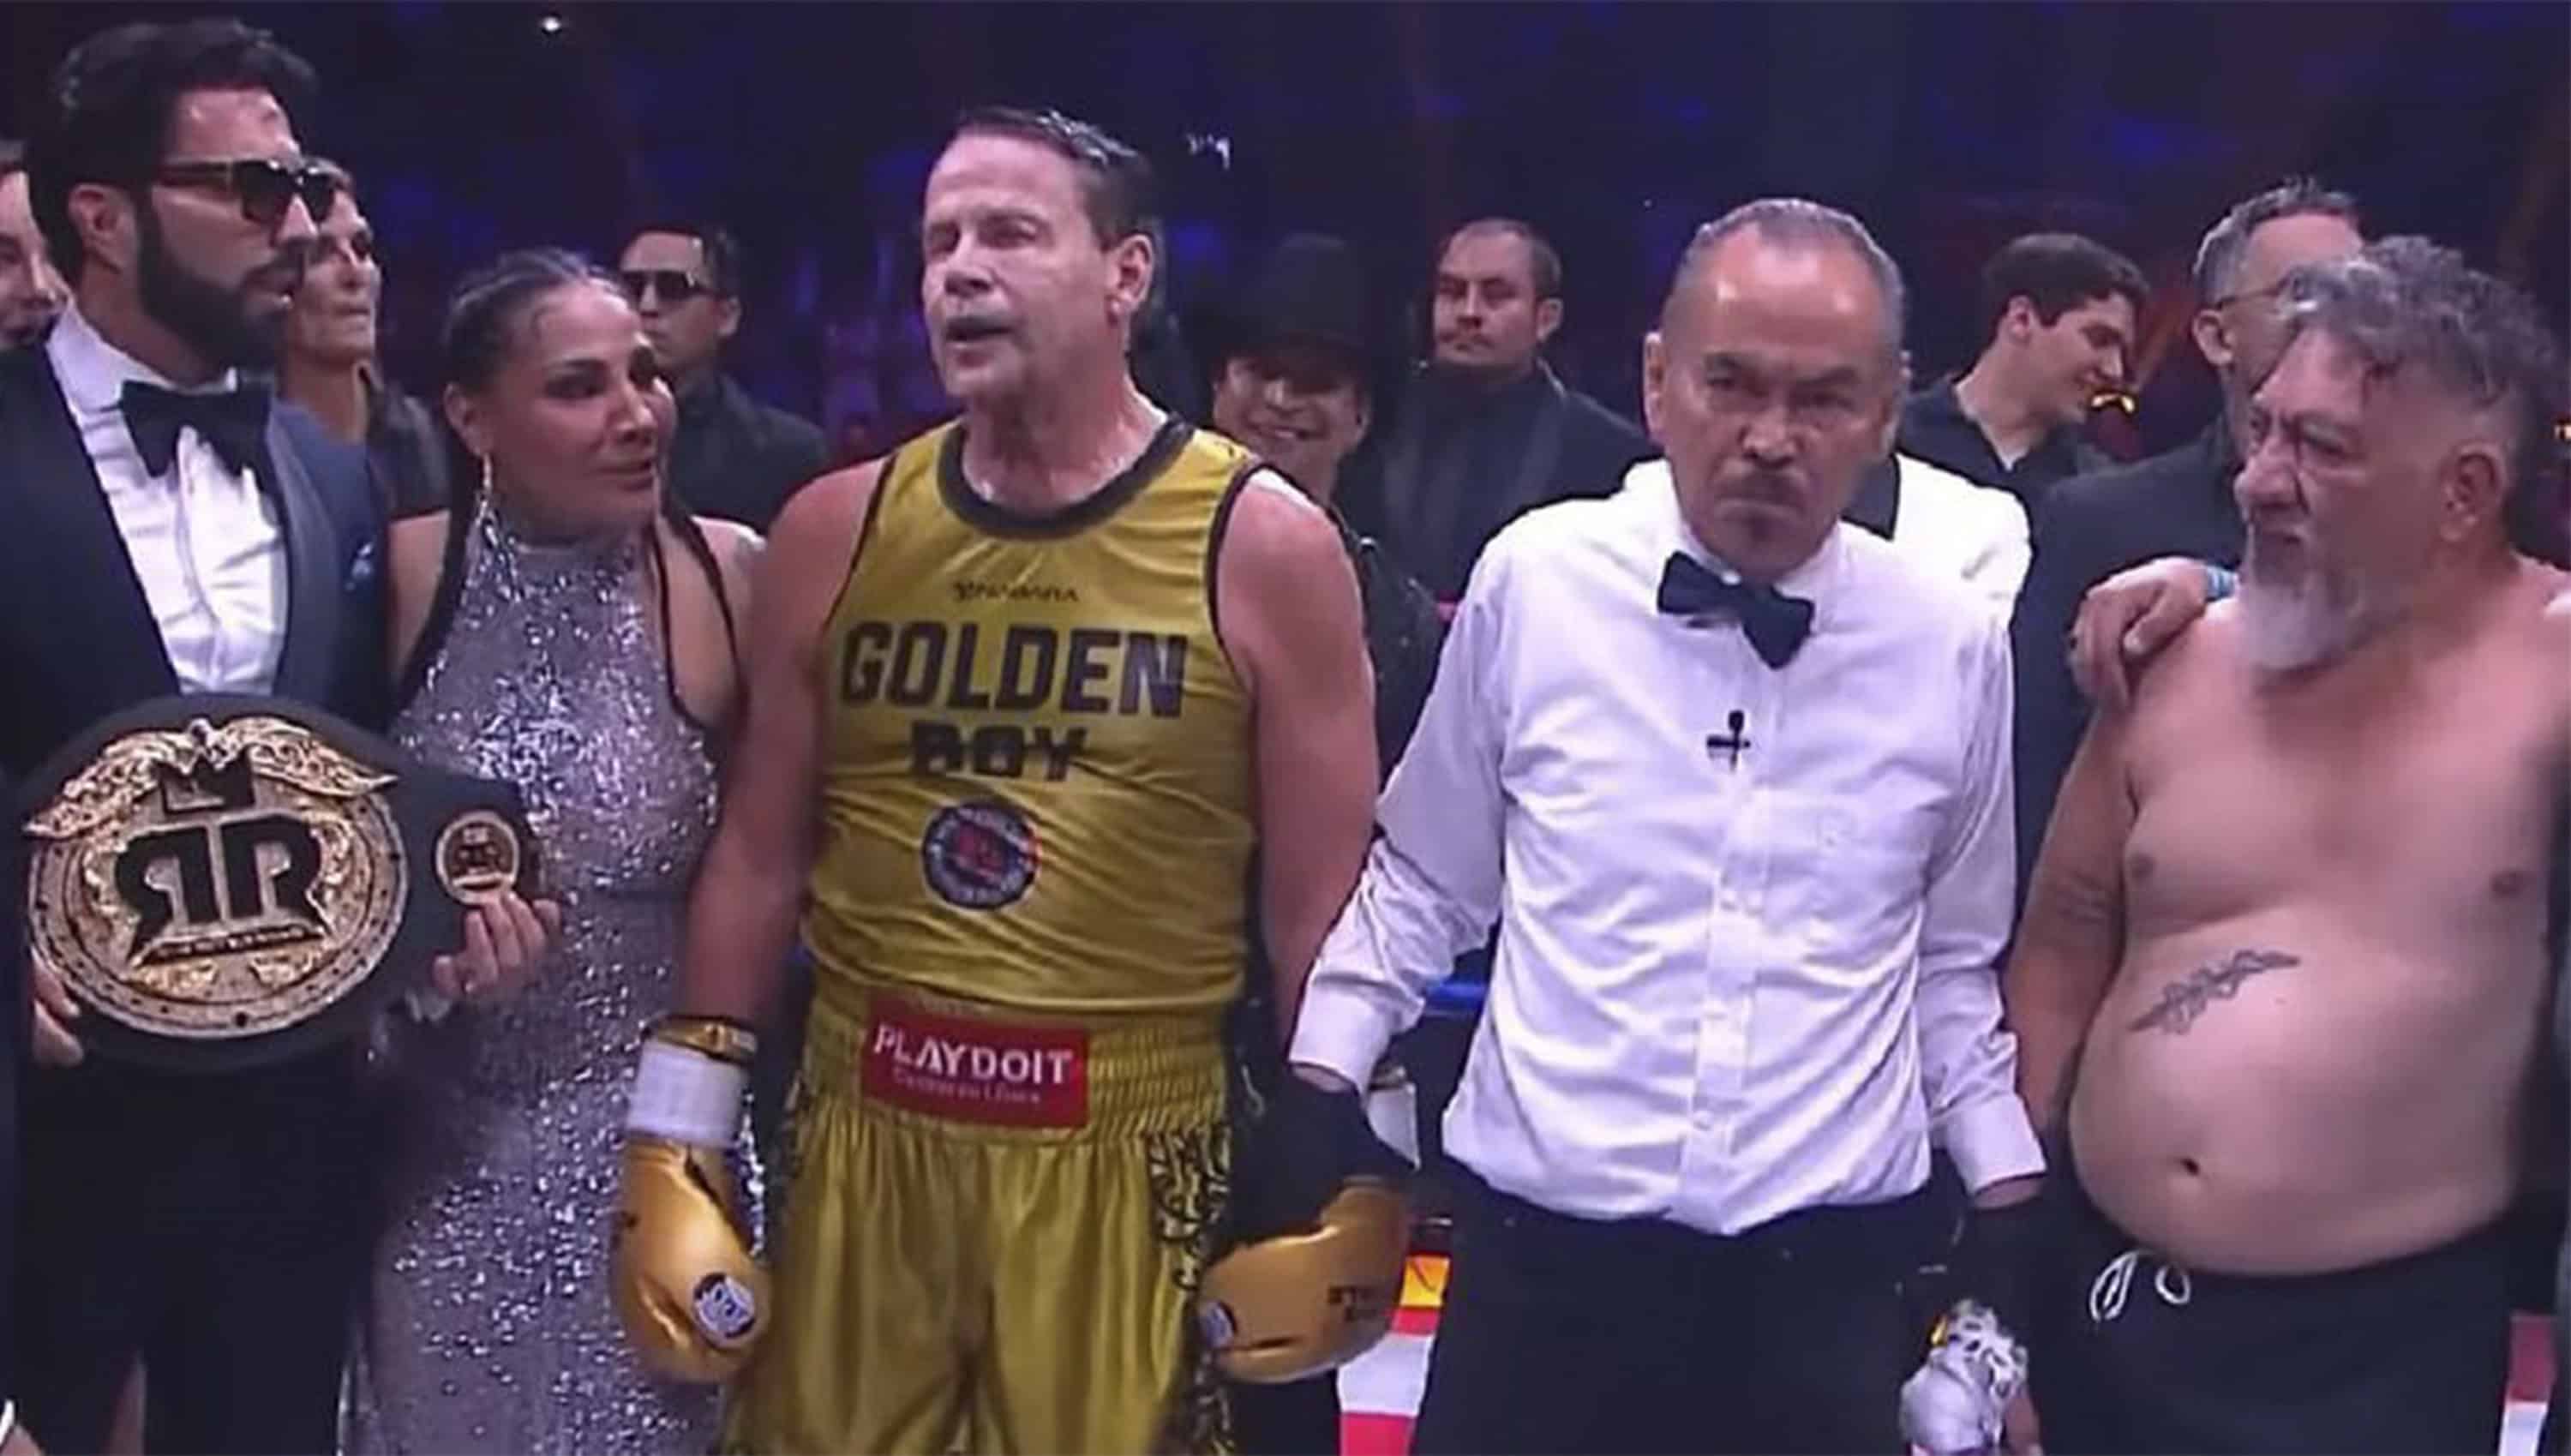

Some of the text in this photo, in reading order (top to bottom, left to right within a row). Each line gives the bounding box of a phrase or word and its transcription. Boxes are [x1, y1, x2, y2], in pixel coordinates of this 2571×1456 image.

[840, 620, 1188, 718] GOLDEN
[908, 720, 1087, 782] BOY
[873, 1024, 1074, 1084] PLAYDOIT
